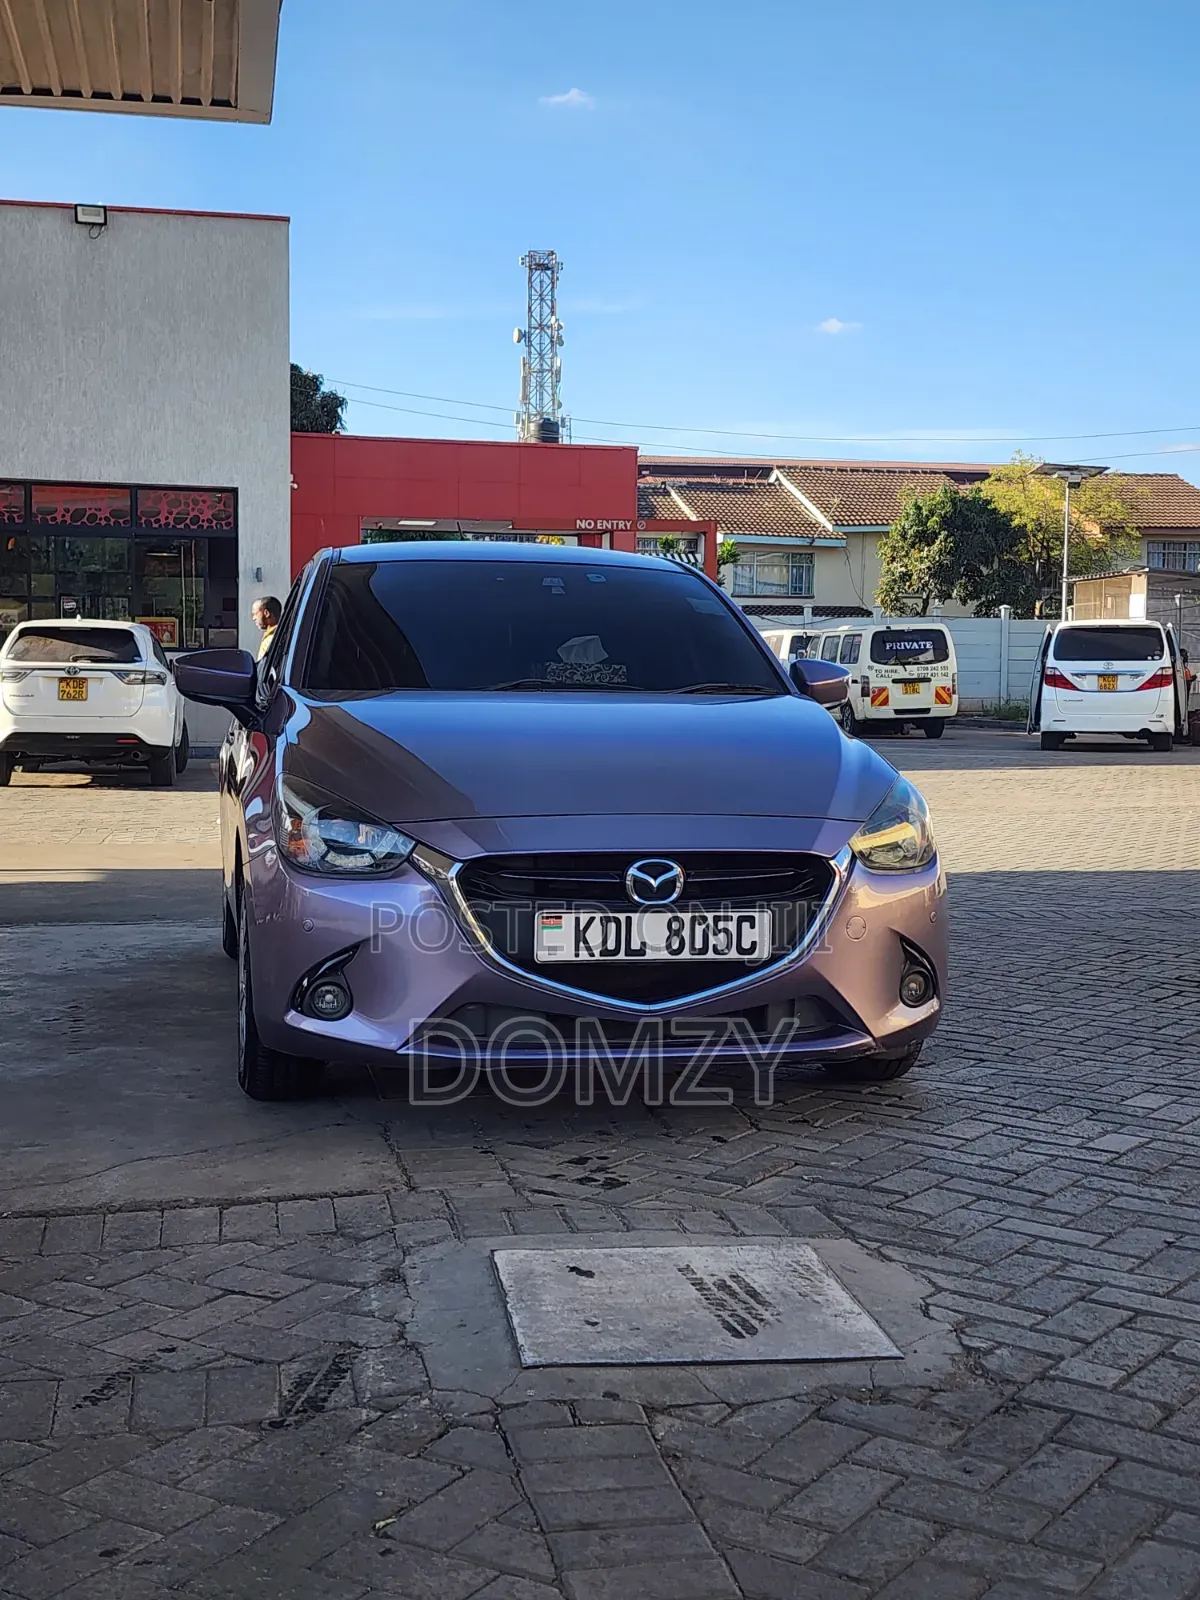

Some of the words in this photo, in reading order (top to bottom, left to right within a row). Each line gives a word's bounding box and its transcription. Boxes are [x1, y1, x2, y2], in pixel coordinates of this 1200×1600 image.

[576, 519, 594, 530] NO
[596, 520, 633, 530] ENTRY
[886, 641, 933, 650] PRIVATE
[65, 680, 85, 690] KDB
[60, 690, 84, 699] 762R
[573, 915, 647, 958] KDL
[665, 914, 758, 957] 805C
